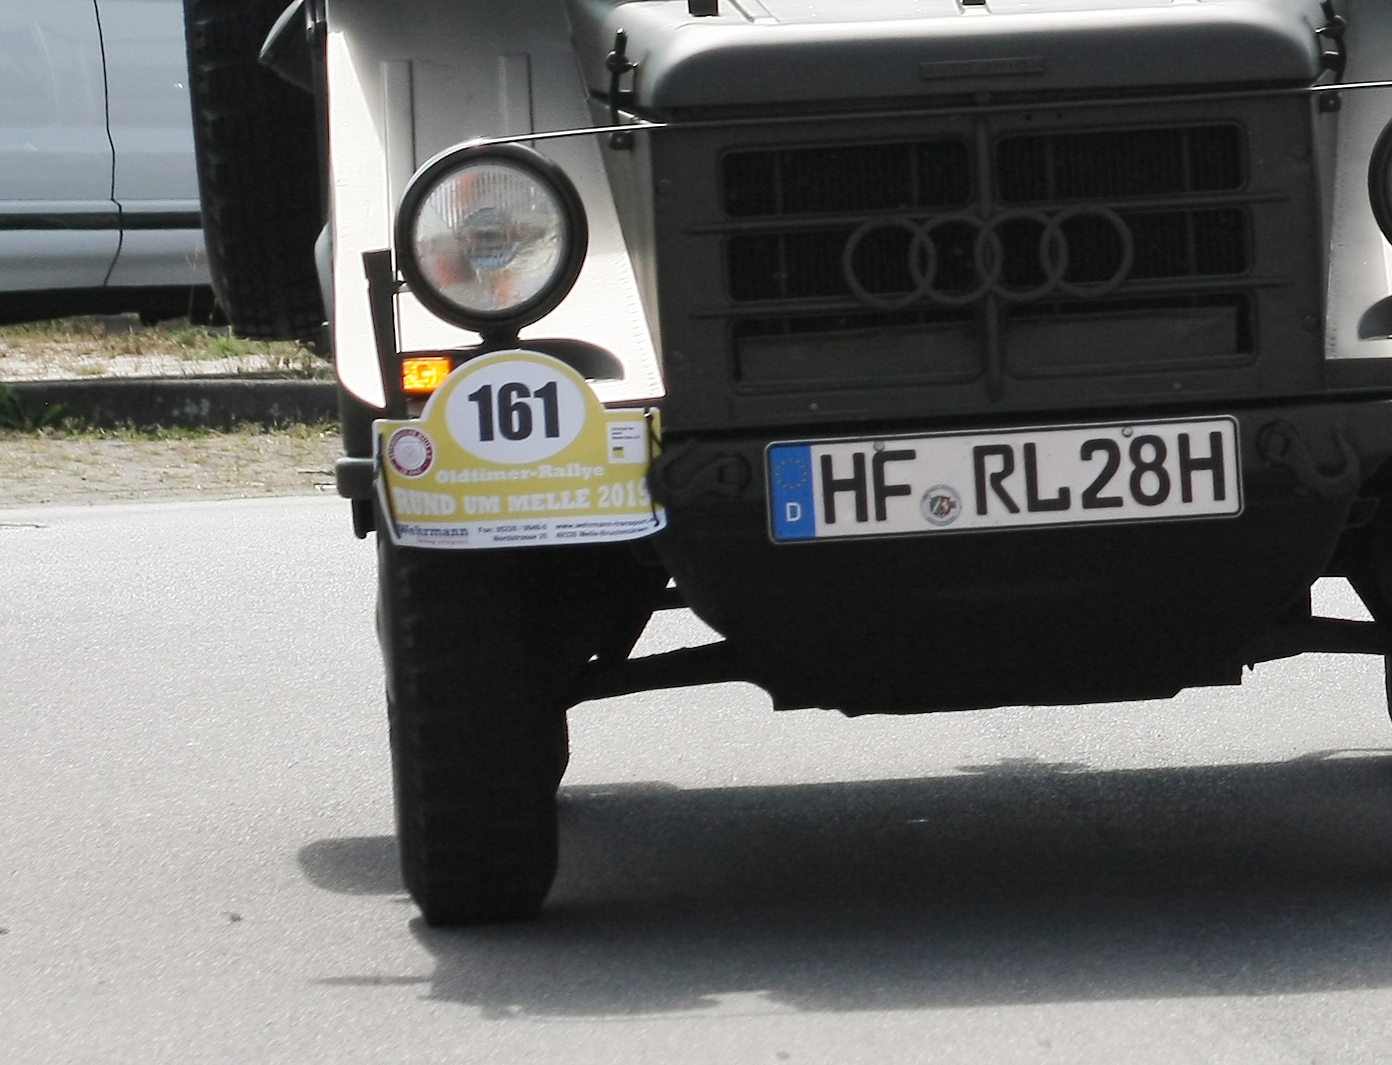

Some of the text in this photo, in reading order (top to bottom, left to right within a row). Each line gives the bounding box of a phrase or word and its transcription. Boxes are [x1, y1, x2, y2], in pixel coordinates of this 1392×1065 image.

[468, 380, 560, 442] 161
[436, 463, 604, 484] Oldtimer-Rallye
[786, 503, 801, 522] D
[820, 449, 916, 524] HF
[394, 487, 456, 515] RUND
[464, 496, 501, 514] UM
[509, 488, 590, 513] MELLE
